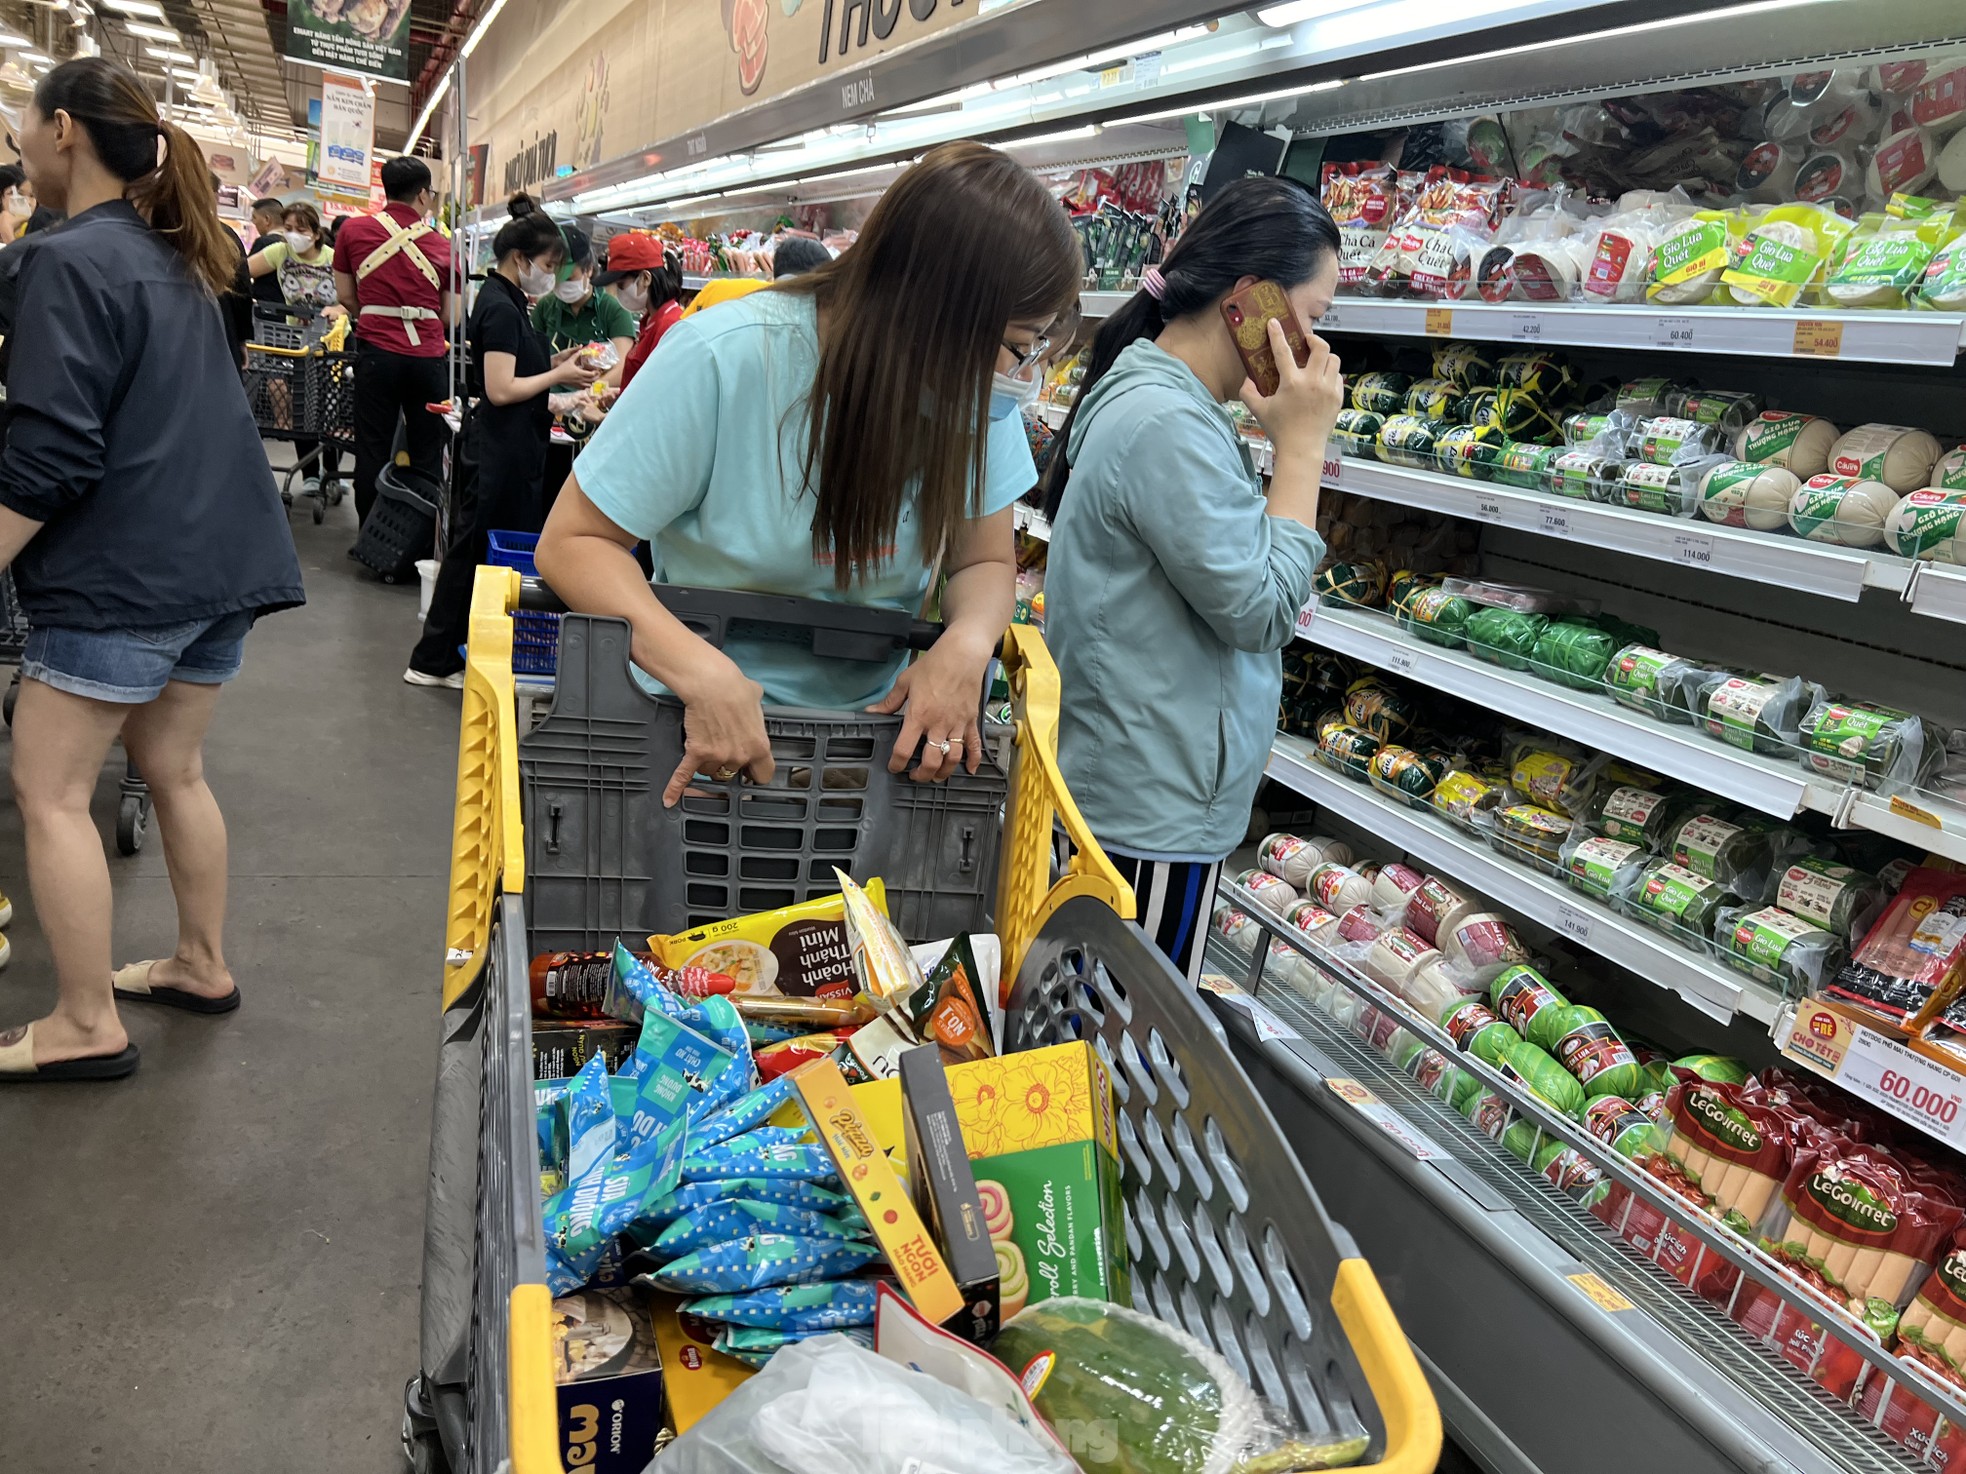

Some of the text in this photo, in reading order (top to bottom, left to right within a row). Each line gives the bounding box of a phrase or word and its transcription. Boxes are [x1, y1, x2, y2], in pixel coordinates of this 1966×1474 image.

[293, 26, 314, 37] EMART
[388, 46, 402, 56] NAM
[841, 70, 875, 109] NEM CHẢ
[720, 922, 739, 932] 200
[799, 926, 840, 952] Mini
[800, 944, 851, 968] Thánh
[802, 960, 855, 986] Hoành
[653, 1083, 677, 1102] KHÔNG
[1879, 1069, 1958, 1124] 60.000
[829, 1108, 874, 1160] Pizza
[1690, 1093, 1758, 1147] LeGourmet
[601, 1175, 630, 1202] SỮA
[1064, 1184, 1073, 1220] FLAVORS
[1813, 1175, 1892, 1227] LeGourmet
[1035, 1180, 1066, 1258] Selection
[910, 1234, 939, 1277] TƯƠI
[1068, 1220, 1077, 1257] PANDAN
[900, 1243, 928, 1283] NGON
[611, 1414, 623, 1453] ORION
